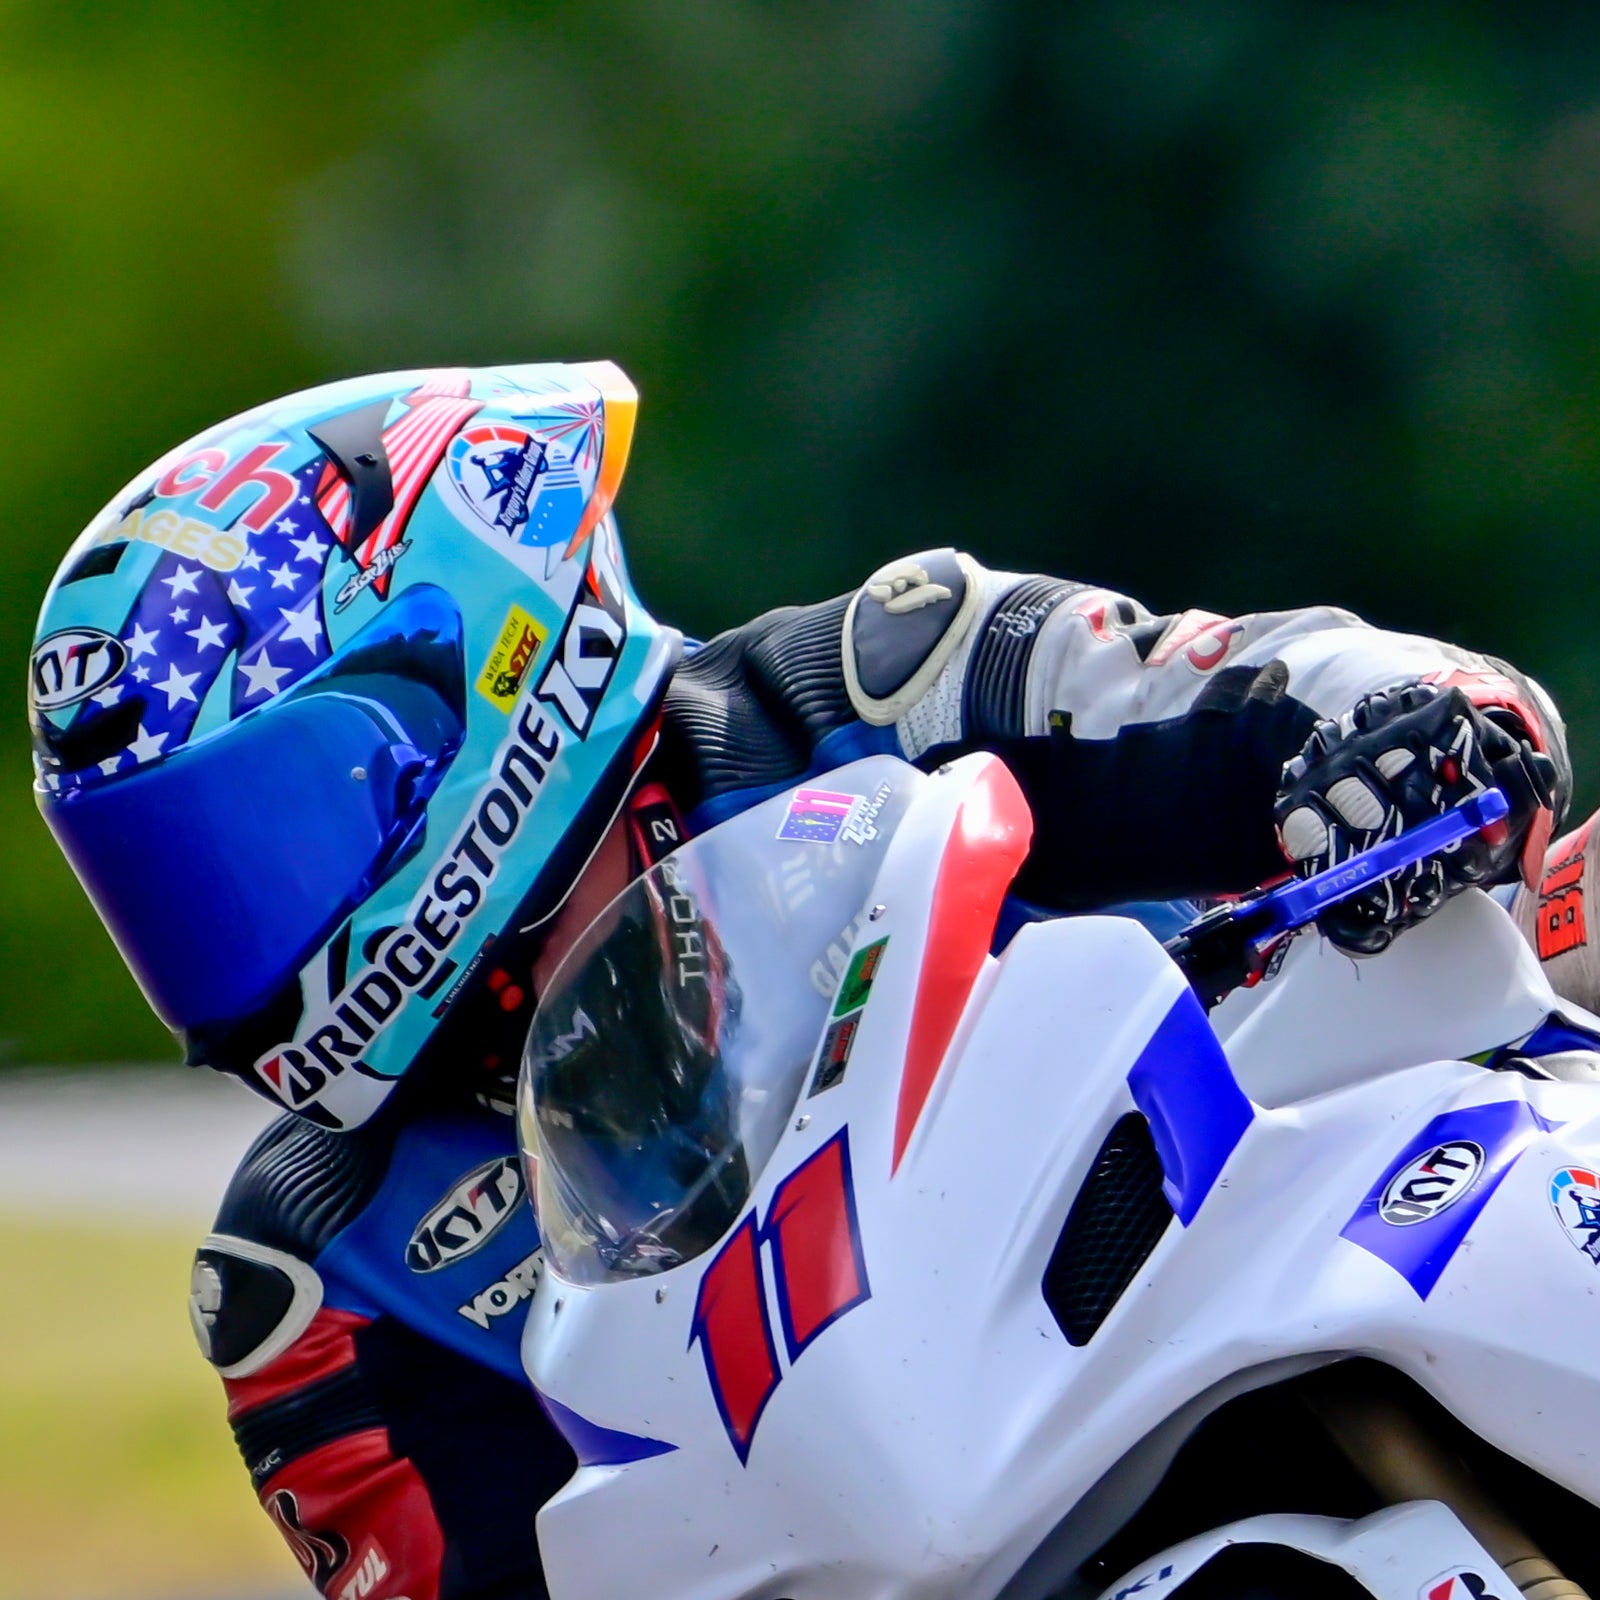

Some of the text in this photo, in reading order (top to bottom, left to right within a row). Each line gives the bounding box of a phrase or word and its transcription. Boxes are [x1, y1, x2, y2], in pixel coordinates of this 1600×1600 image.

[261, 701, 560, 1105] BRIDGESTONE
[404, 1158, 509, 1270] KYT
[686, 1123, 873, 1468] 11
